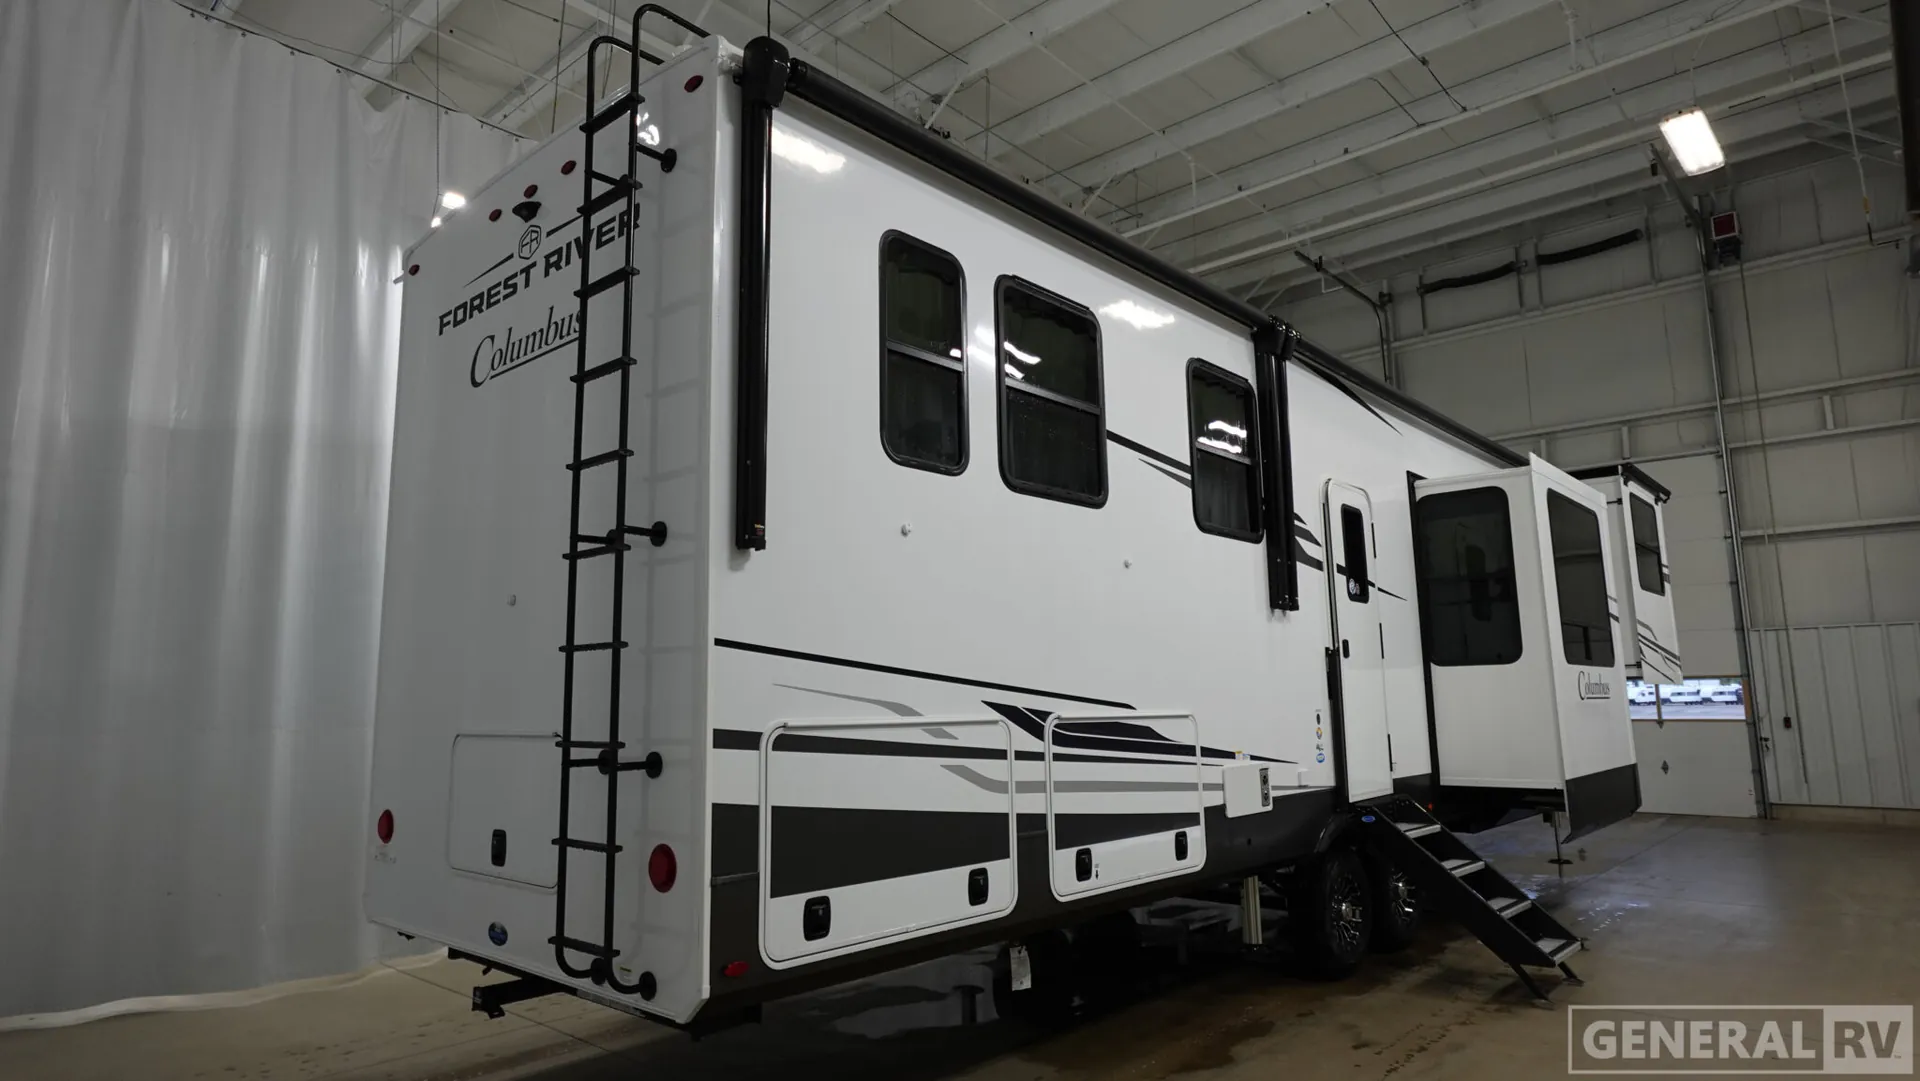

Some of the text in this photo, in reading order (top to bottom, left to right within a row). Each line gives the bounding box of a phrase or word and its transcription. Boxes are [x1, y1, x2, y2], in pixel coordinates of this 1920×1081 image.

[438, 202, 640, 336] FOREST RIVER
[1577, 670, 1611, 701] Columbus
